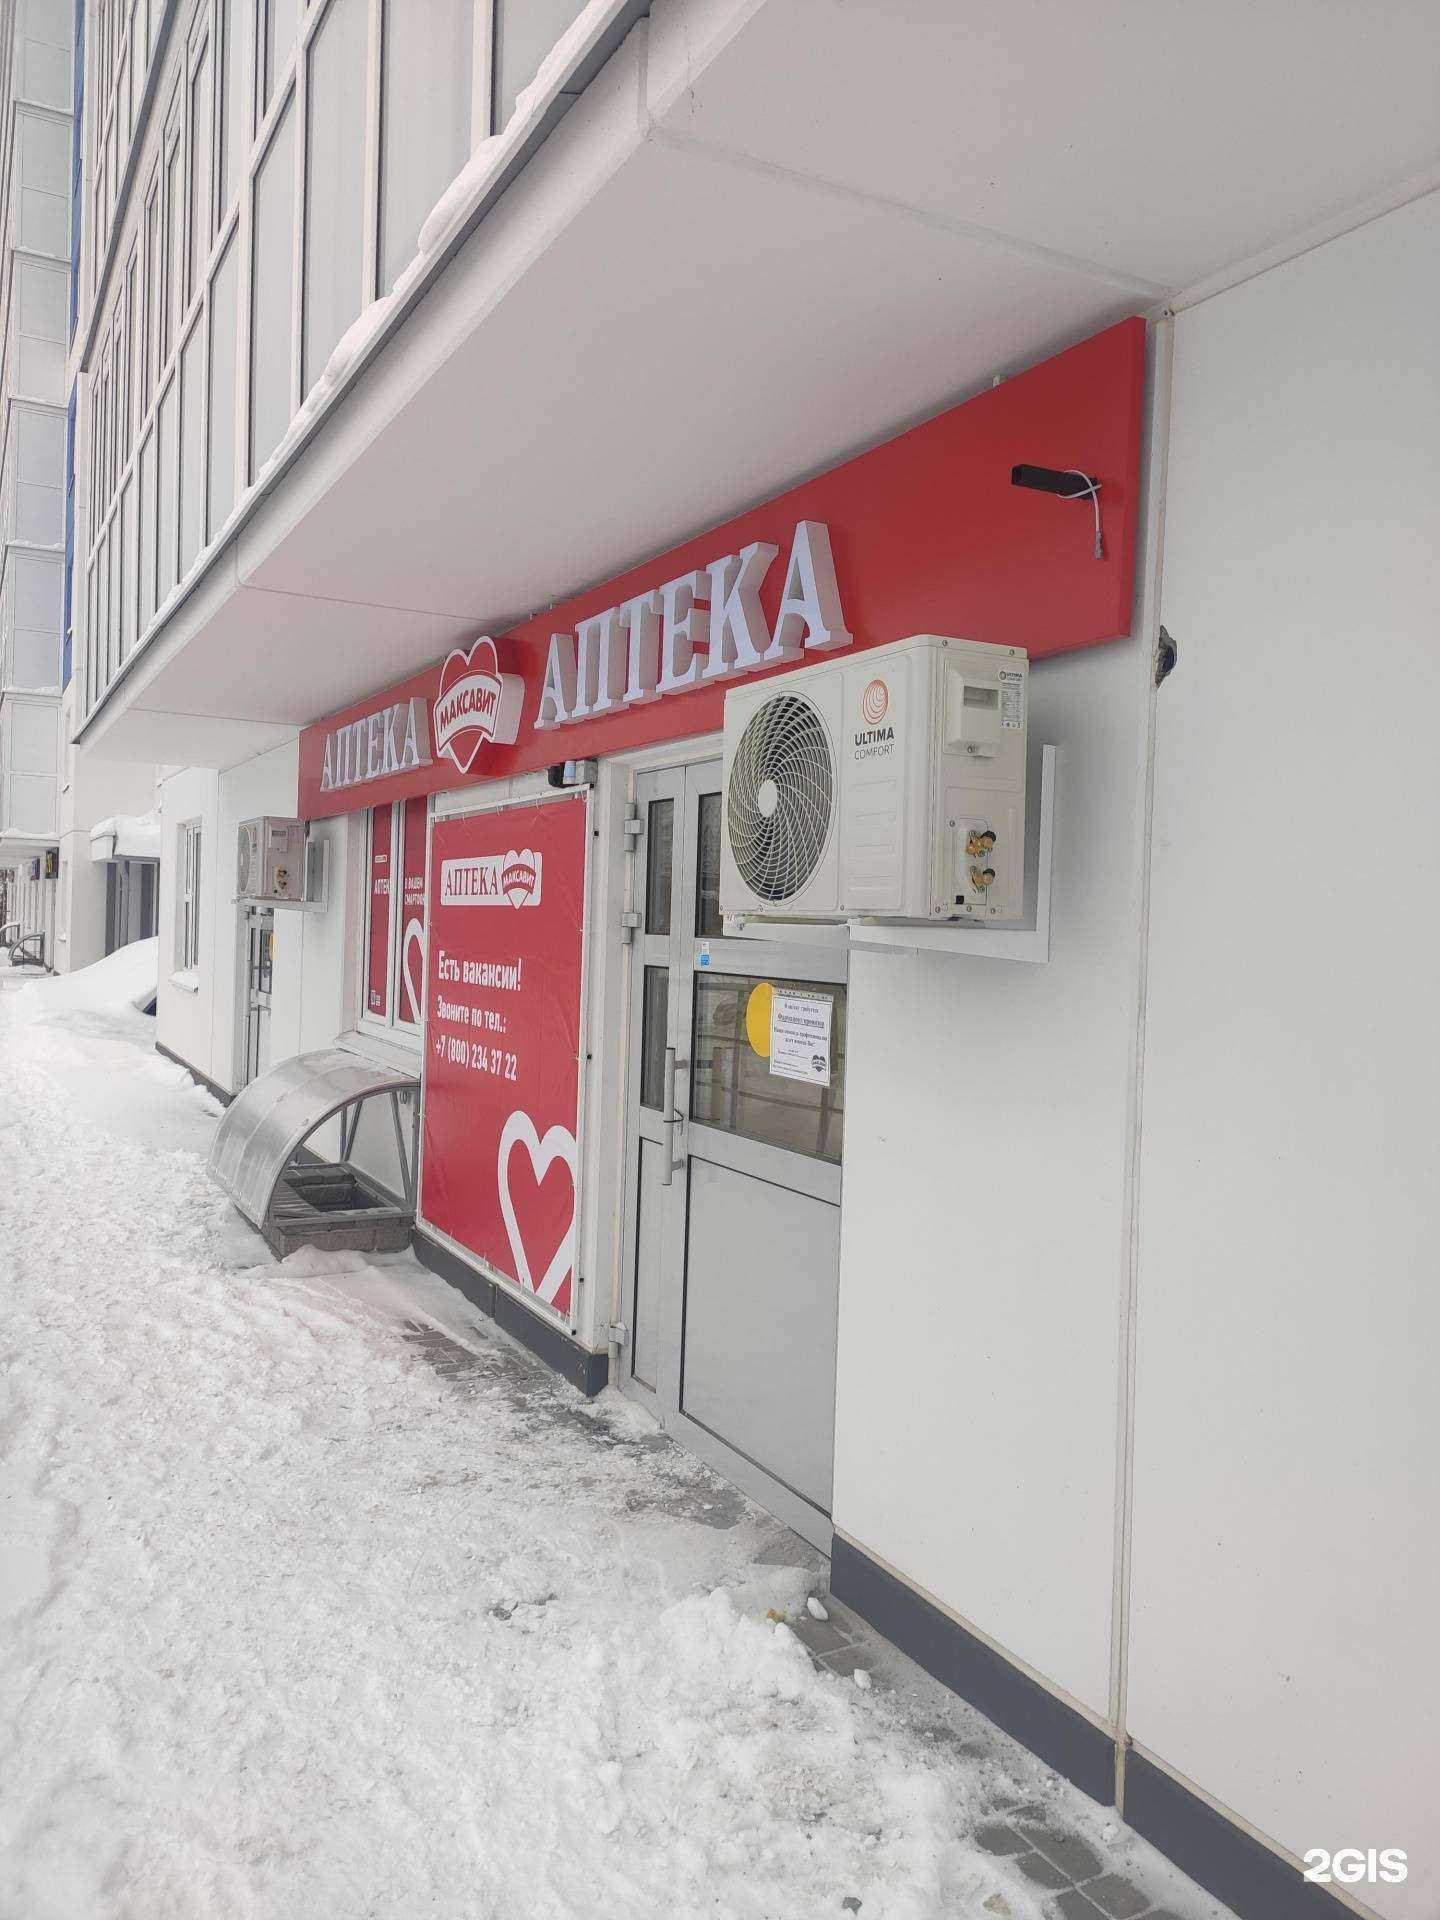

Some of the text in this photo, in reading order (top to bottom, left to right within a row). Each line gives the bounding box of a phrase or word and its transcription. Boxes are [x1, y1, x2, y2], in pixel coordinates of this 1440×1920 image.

[534, 520, 852, 729] АПТЕКА
[440, 686, 497, 734] МАКСАВИТ
[319, 697, 432, 791] АПТЕКА
[854, 727, 895, 747] ULTIMA
[854, 743, 895, 760] COMFORT
[444, 865, 536, 897] АПТЕКА МАКСАВИТ
[438, 950, 523, 992] Есть вакансии!
[437, 994, 507, 1034] Звоните по тел.:
[436, 1034, 518, 1081] +7 (800) 234 37 22
